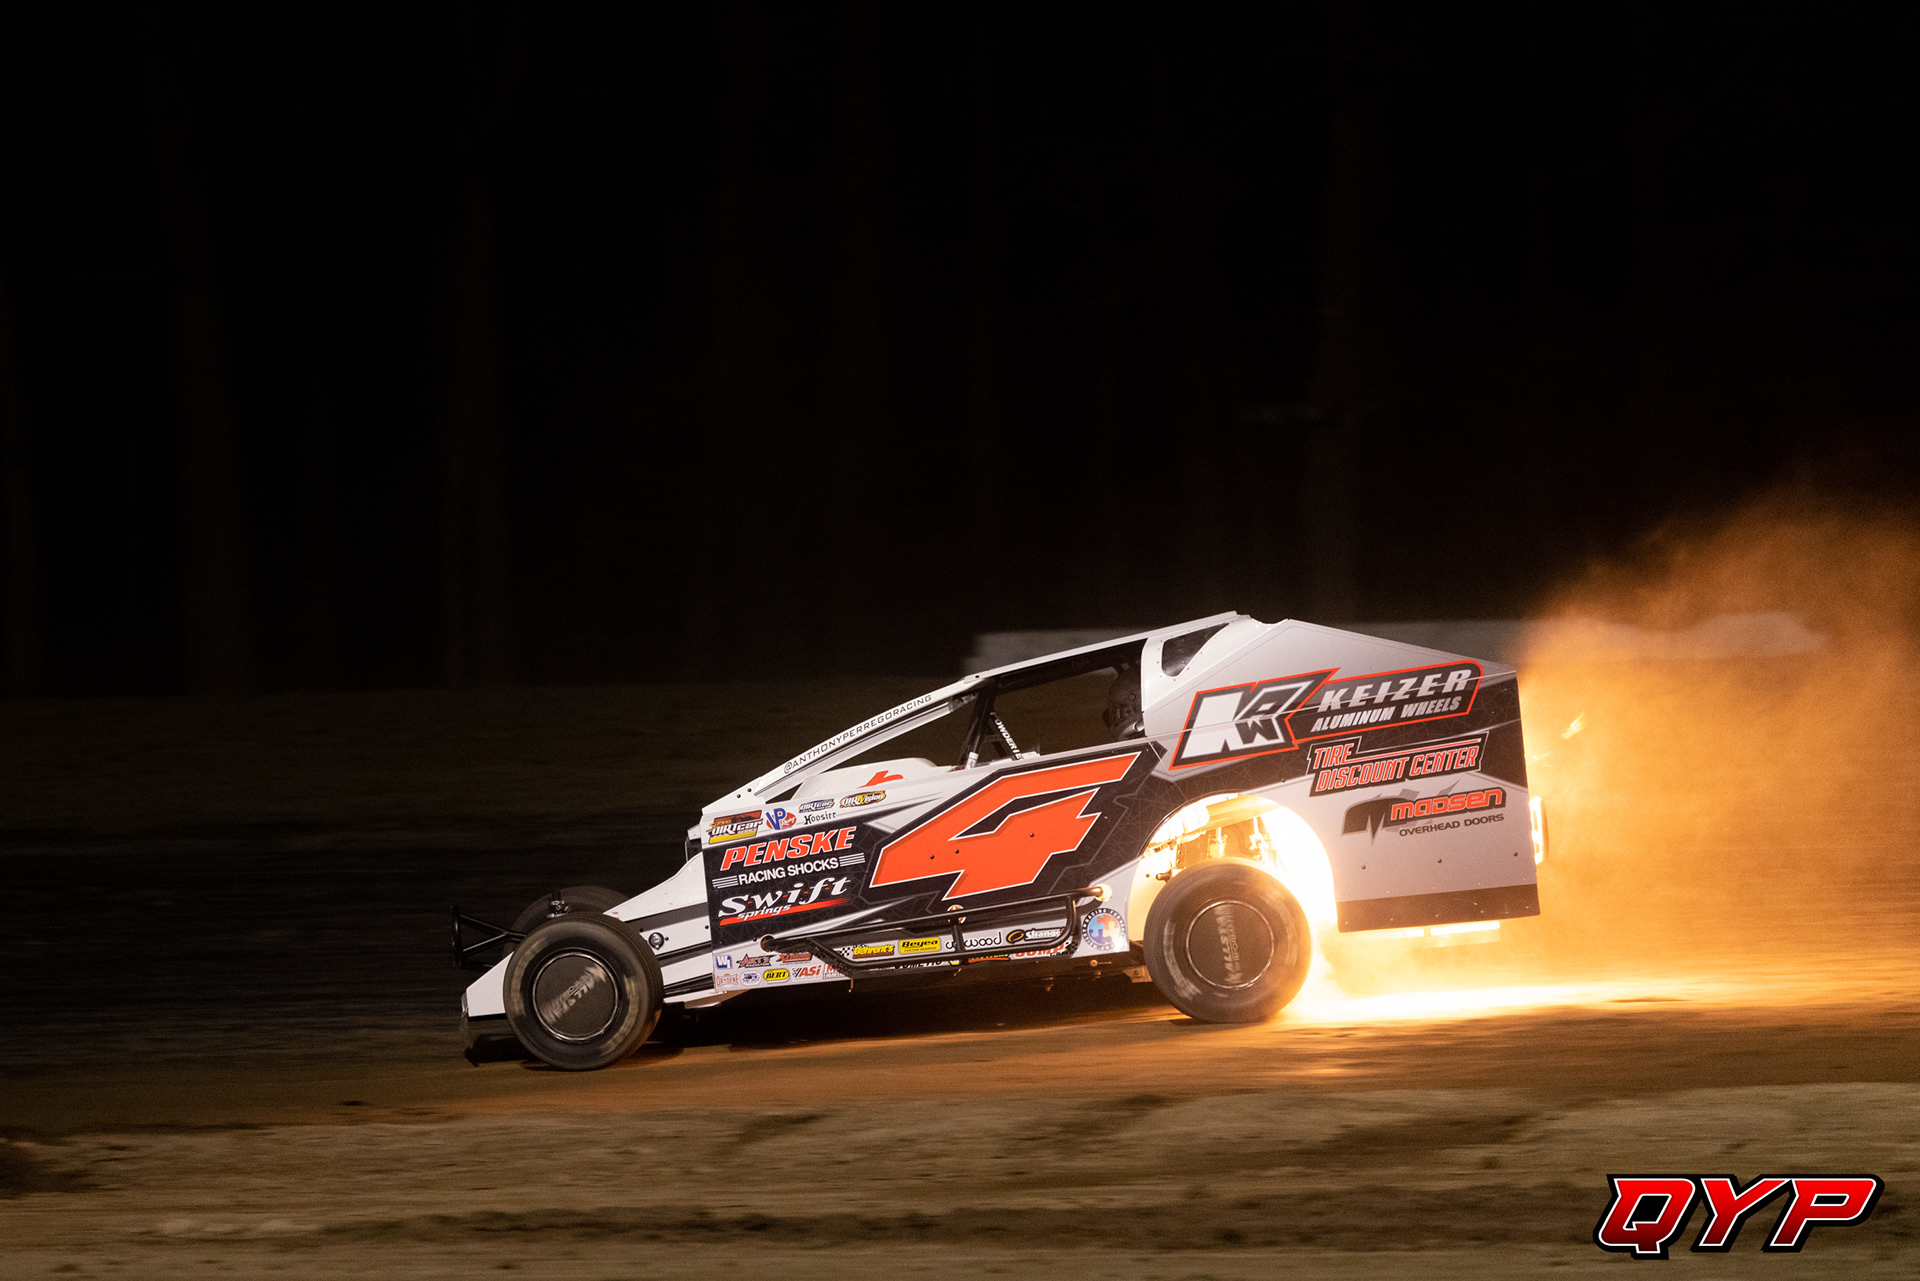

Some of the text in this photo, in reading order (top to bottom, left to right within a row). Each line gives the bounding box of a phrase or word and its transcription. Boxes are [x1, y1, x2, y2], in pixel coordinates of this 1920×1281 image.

[1317, 669, 1472, 713] KEIZER
[1311, 696, 1462, 733] ALUMINUM WHEELS
[783, 694, 932, 774] @ANTHONYPERREGORACING
[1312, 743, 1355, 770] TIRE
[1315, 746, 1480, 793] DISCOUNT CENTER
[765, 808, 787, 831] VP
[803, 811, 837, 825] Hoosier
[868, 750, 1142, 901] 4
[1399, 813, 1505, 837] OVERHEAD DOORS
[719, 826, 858, 872] PENSKE
[738, 857, 840, 886] RACING SHOCKS
[736, 904, 792, 921] springs
[901, 939, 939, 948] Beyea
[946, 931, 1002, 950] wwood
